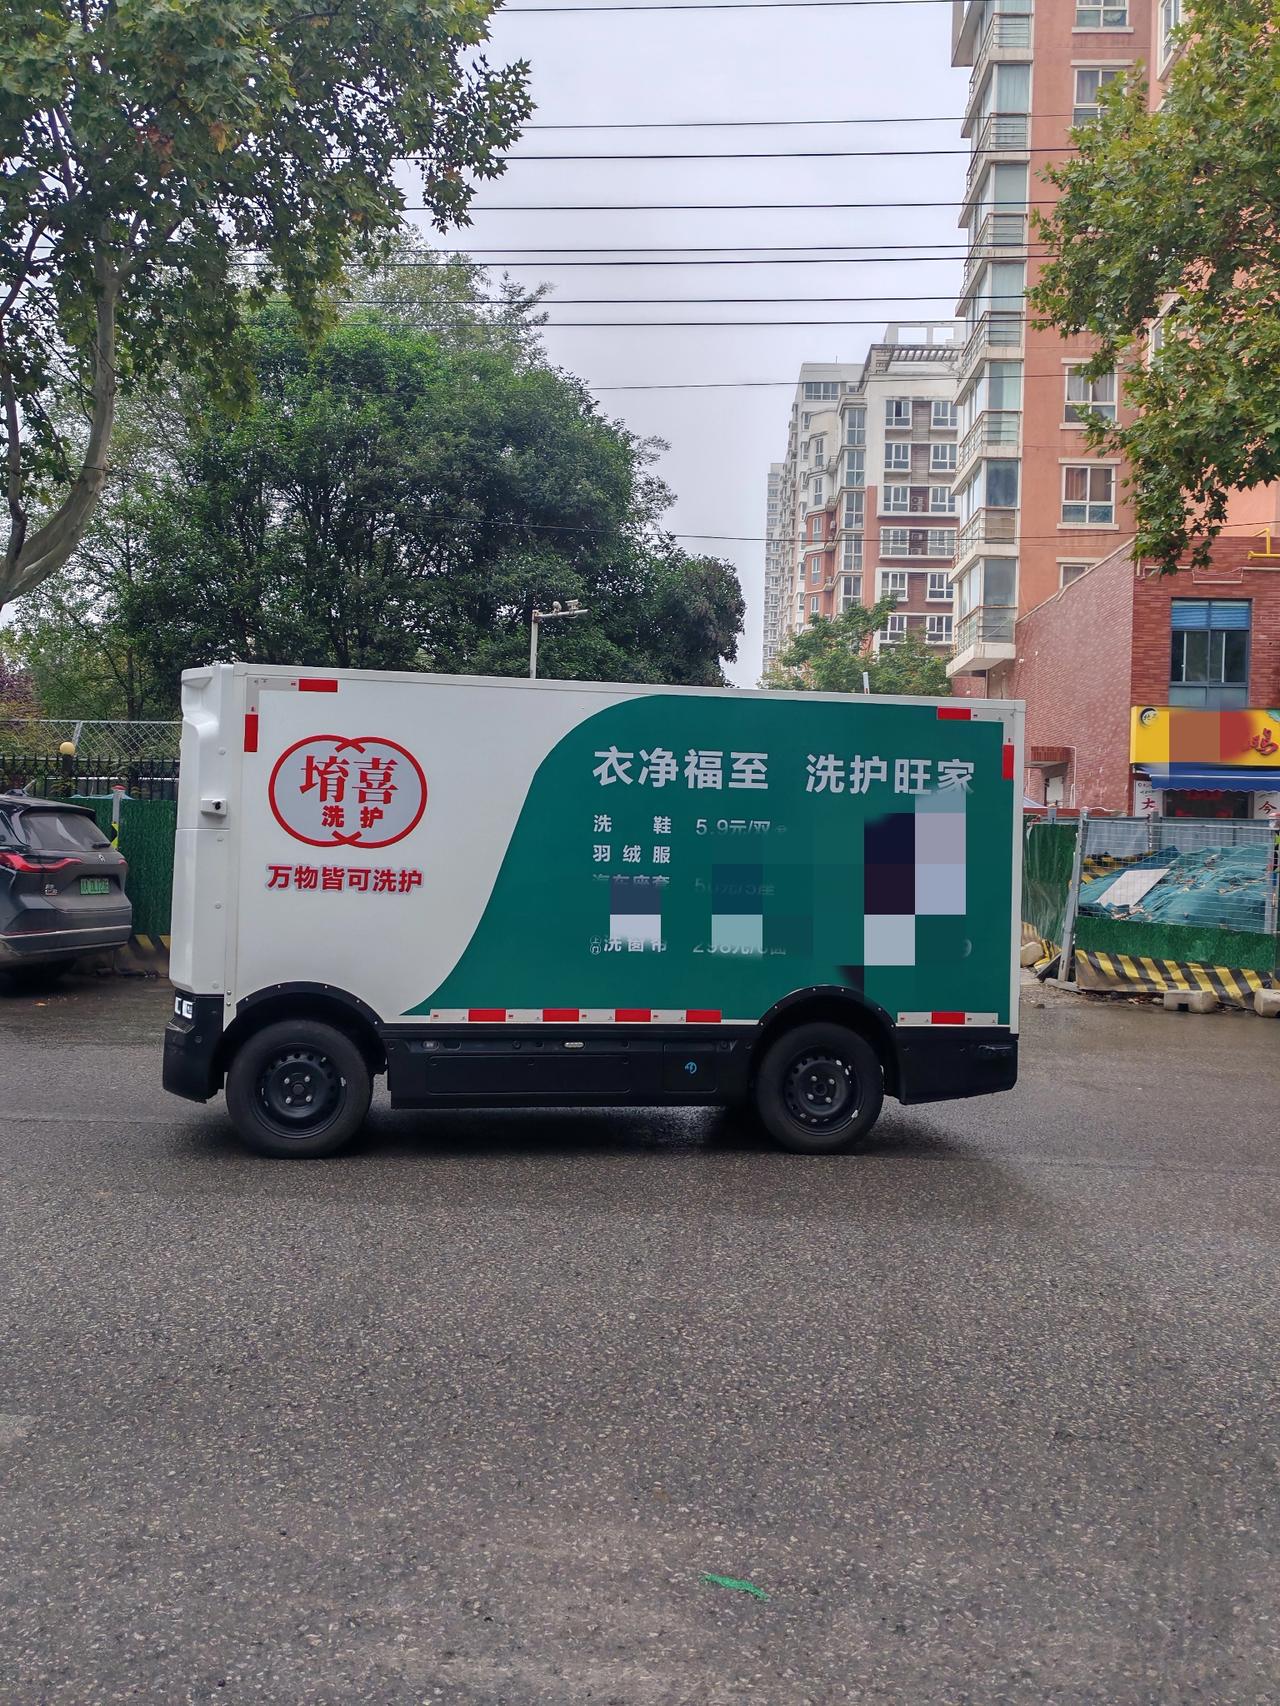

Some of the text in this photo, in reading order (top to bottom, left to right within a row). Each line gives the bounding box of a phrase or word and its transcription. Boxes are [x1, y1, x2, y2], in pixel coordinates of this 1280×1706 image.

[592, 745, 975, 795] 衣净福至 洗护旺家
[321, 805, 384, 829] 洗护
[592, 844, 671, 864] 羽绒服
[266, 864, 423, 893] 万物皆可洗护
